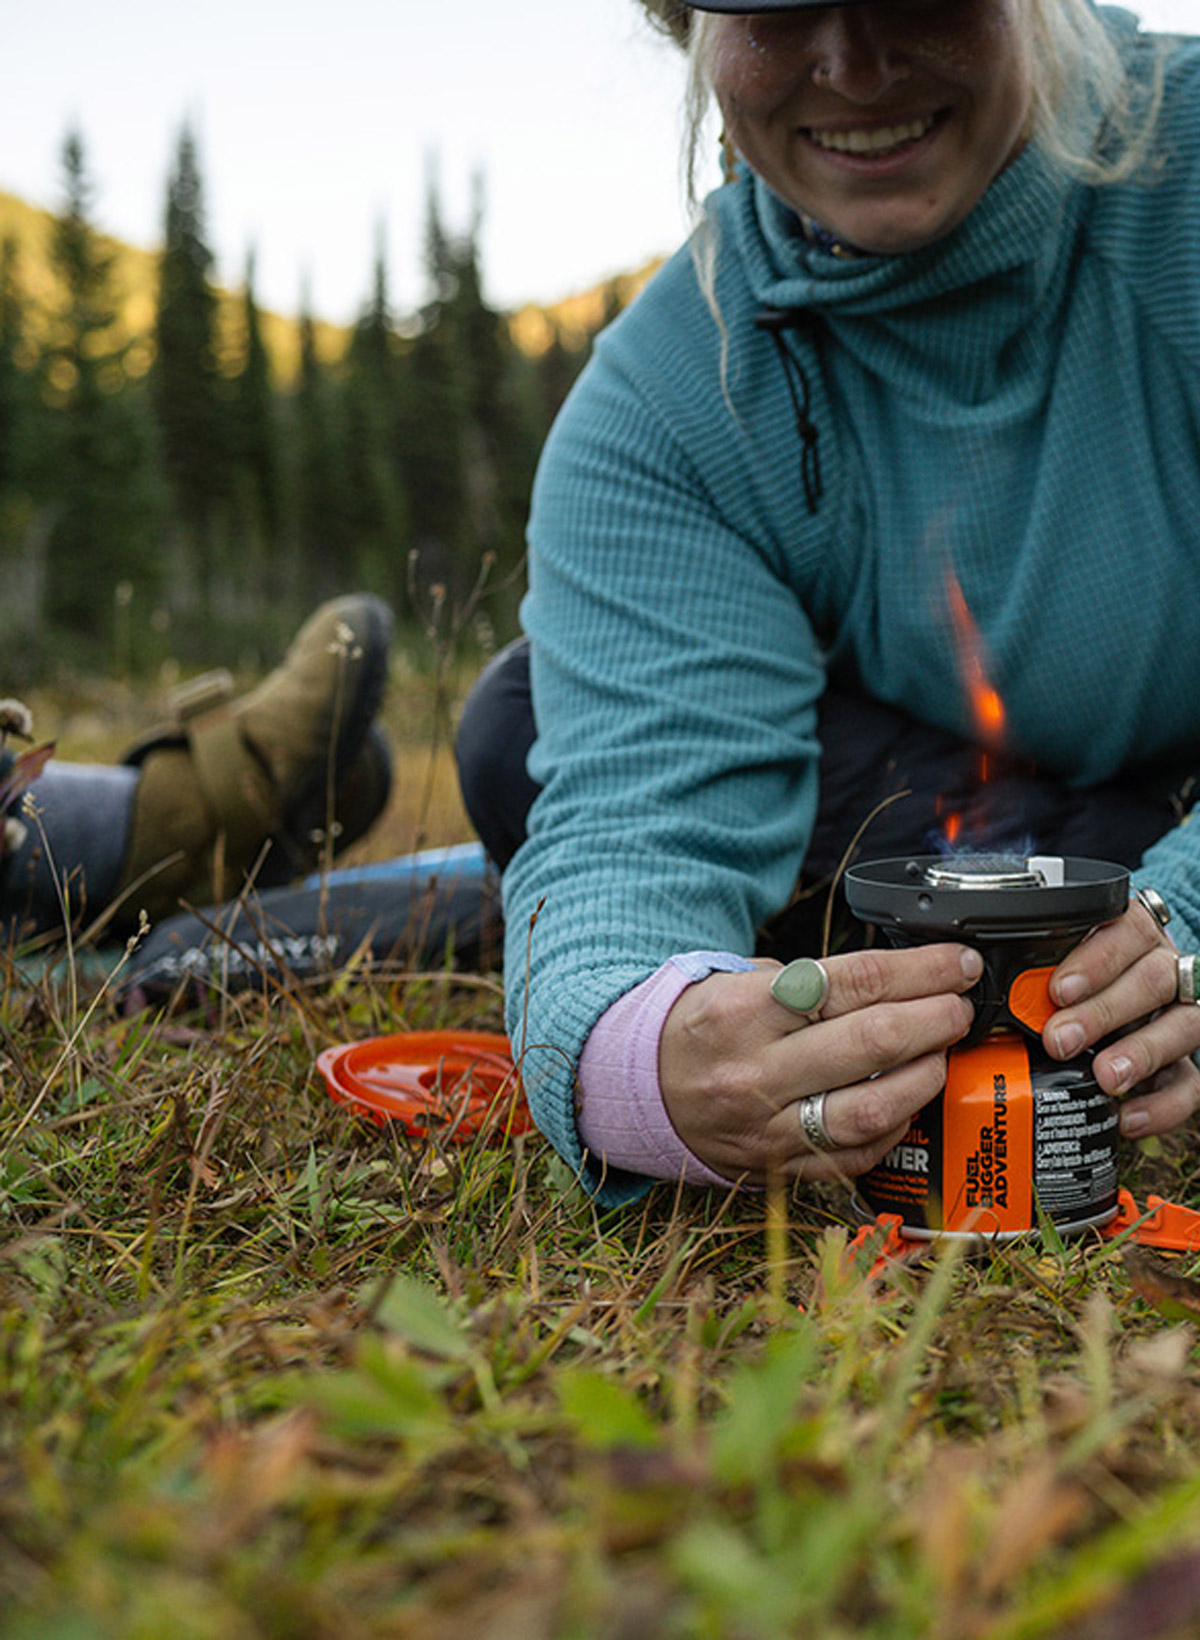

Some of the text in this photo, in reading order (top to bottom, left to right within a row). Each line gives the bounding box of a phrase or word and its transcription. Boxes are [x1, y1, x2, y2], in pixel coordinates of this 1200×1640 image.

[966, 1150, 979, 1208] FUEL
[981, 1126, 993, 1208] BIGGER
[994, 1073, 1007, 1209] ADVENTURES
